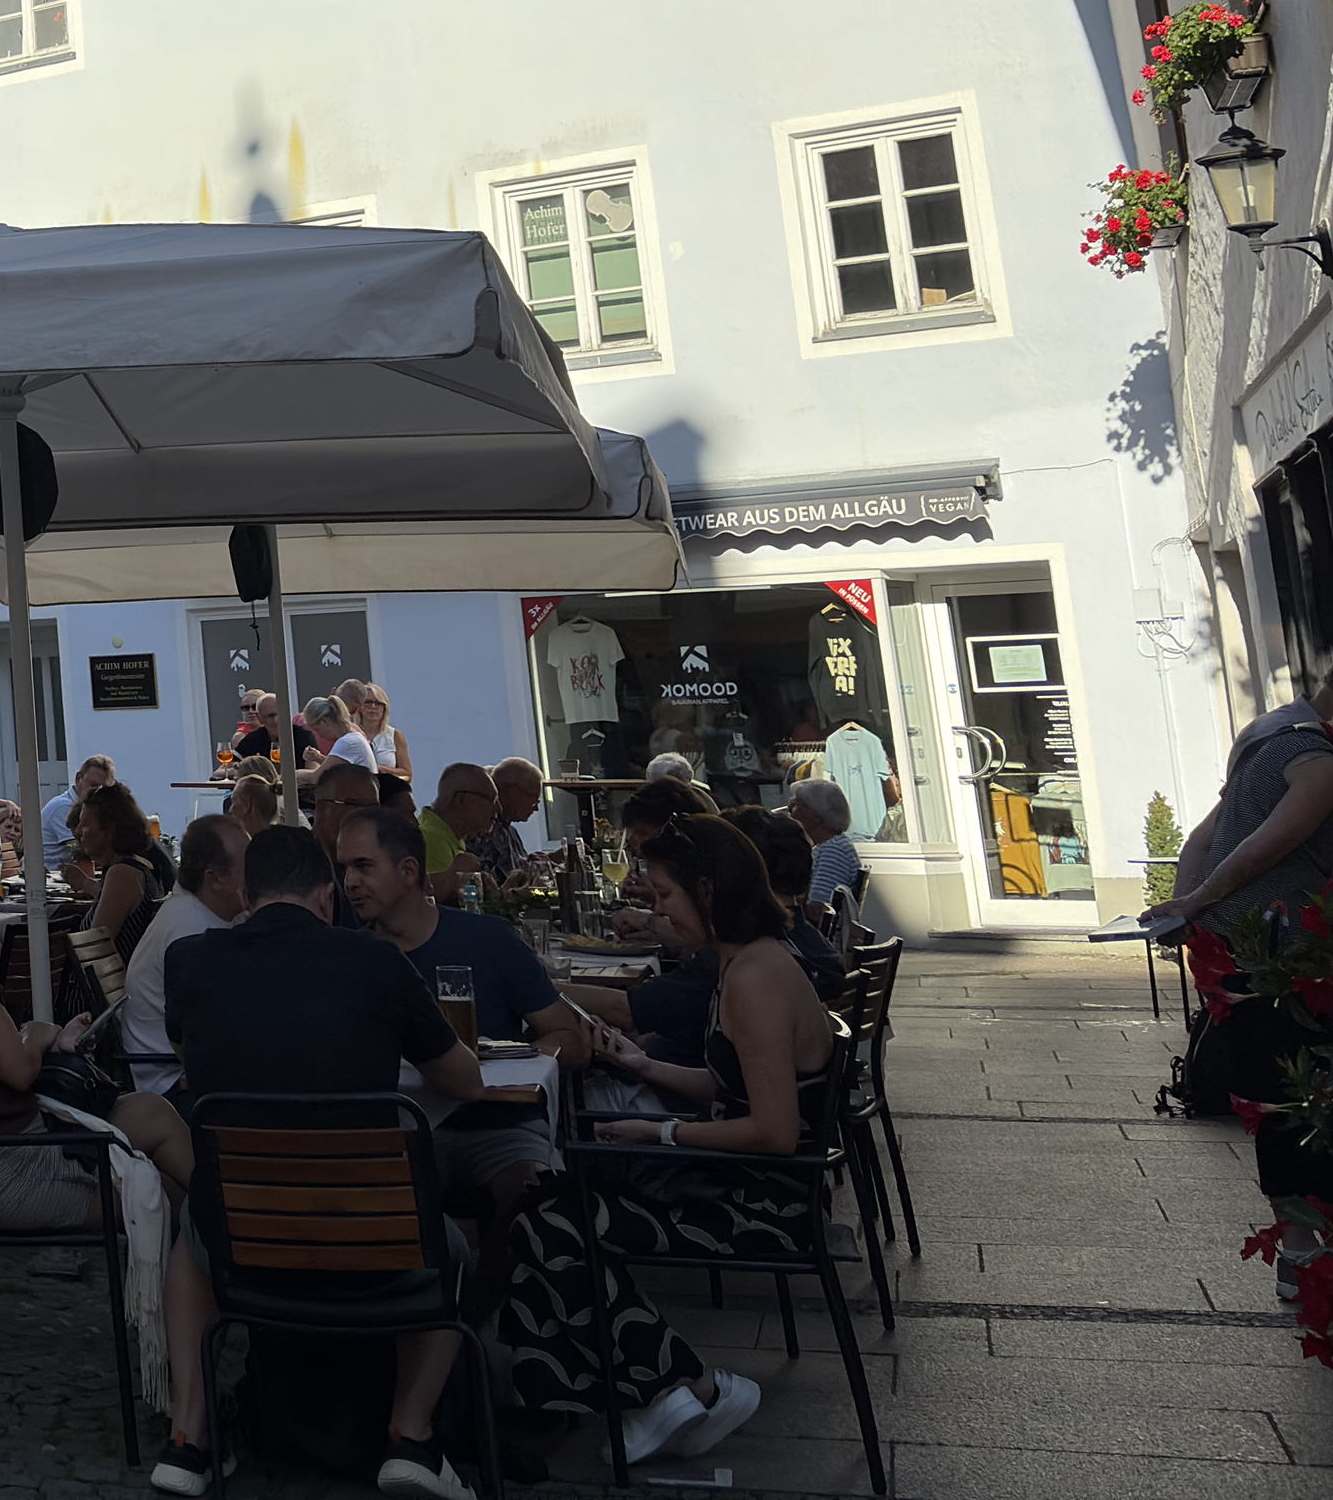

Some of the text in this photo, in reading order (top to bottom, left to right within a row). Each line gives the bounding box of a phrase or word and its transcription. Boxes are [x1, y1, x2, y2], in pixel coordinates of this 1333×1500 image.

[743, 507, 781, 526] AUS
[784, 504, 827, 523] DEM
[831, 496, 907, 520] ALLGÄU
[929, 502, 970, 513] VEGAN
[847, 582, 871, 603] NEU
[95, 661, 149, 670] ACHIM HOFER
[660, 682, 738, 697] KOMOOD
